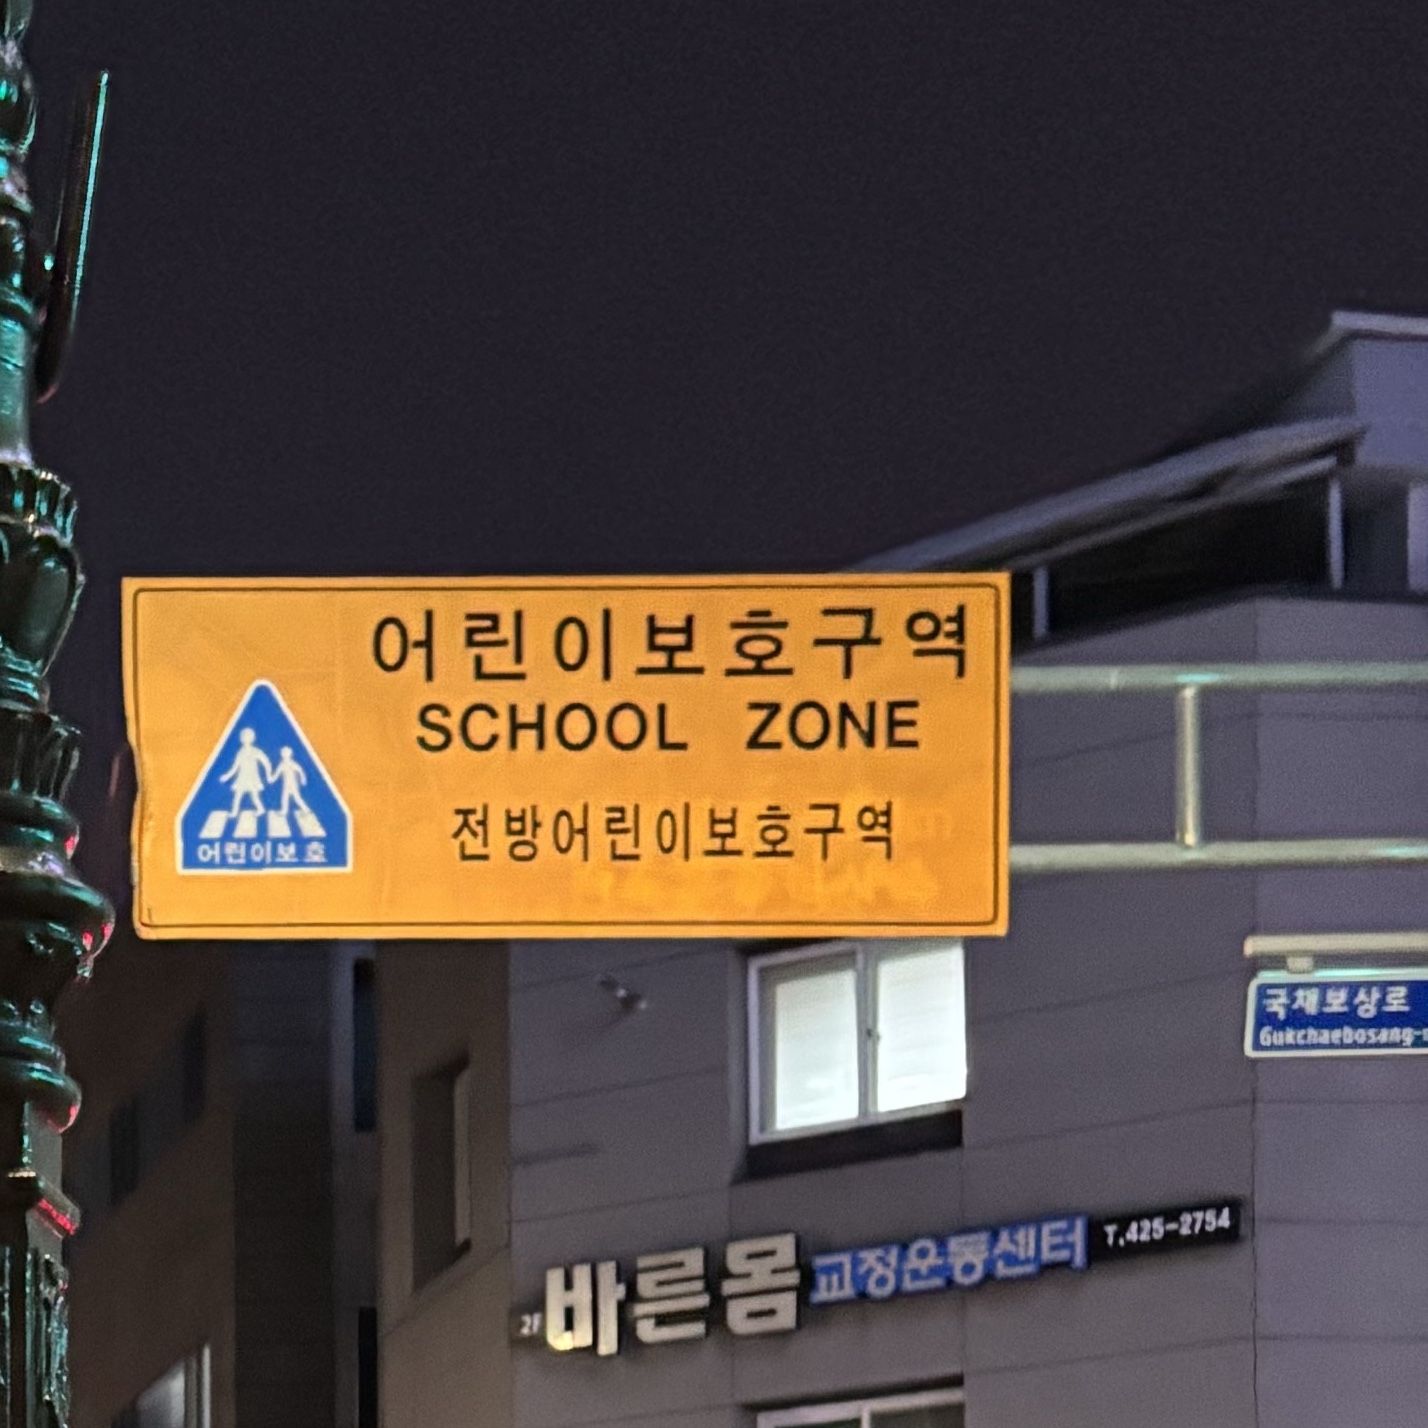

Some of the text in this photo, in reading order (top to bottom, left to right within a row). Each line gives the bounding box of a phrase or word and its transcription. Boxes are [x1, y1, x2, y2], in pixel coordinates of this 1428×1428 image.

[372, 602, 969, 682] 어린이보호구역
[416, 699, 922, 754] SCHOOL ZONE
[197, 840, 329, 865] 어린이보호
[451, 800, 897, 863] 전방어린이보호구역
[1262, 985, 1412, 1021] 국채보상로
[545, 1231, 801, 1357] 바른몸
[1103, 1206, 1231, 1248] T.425-2754
